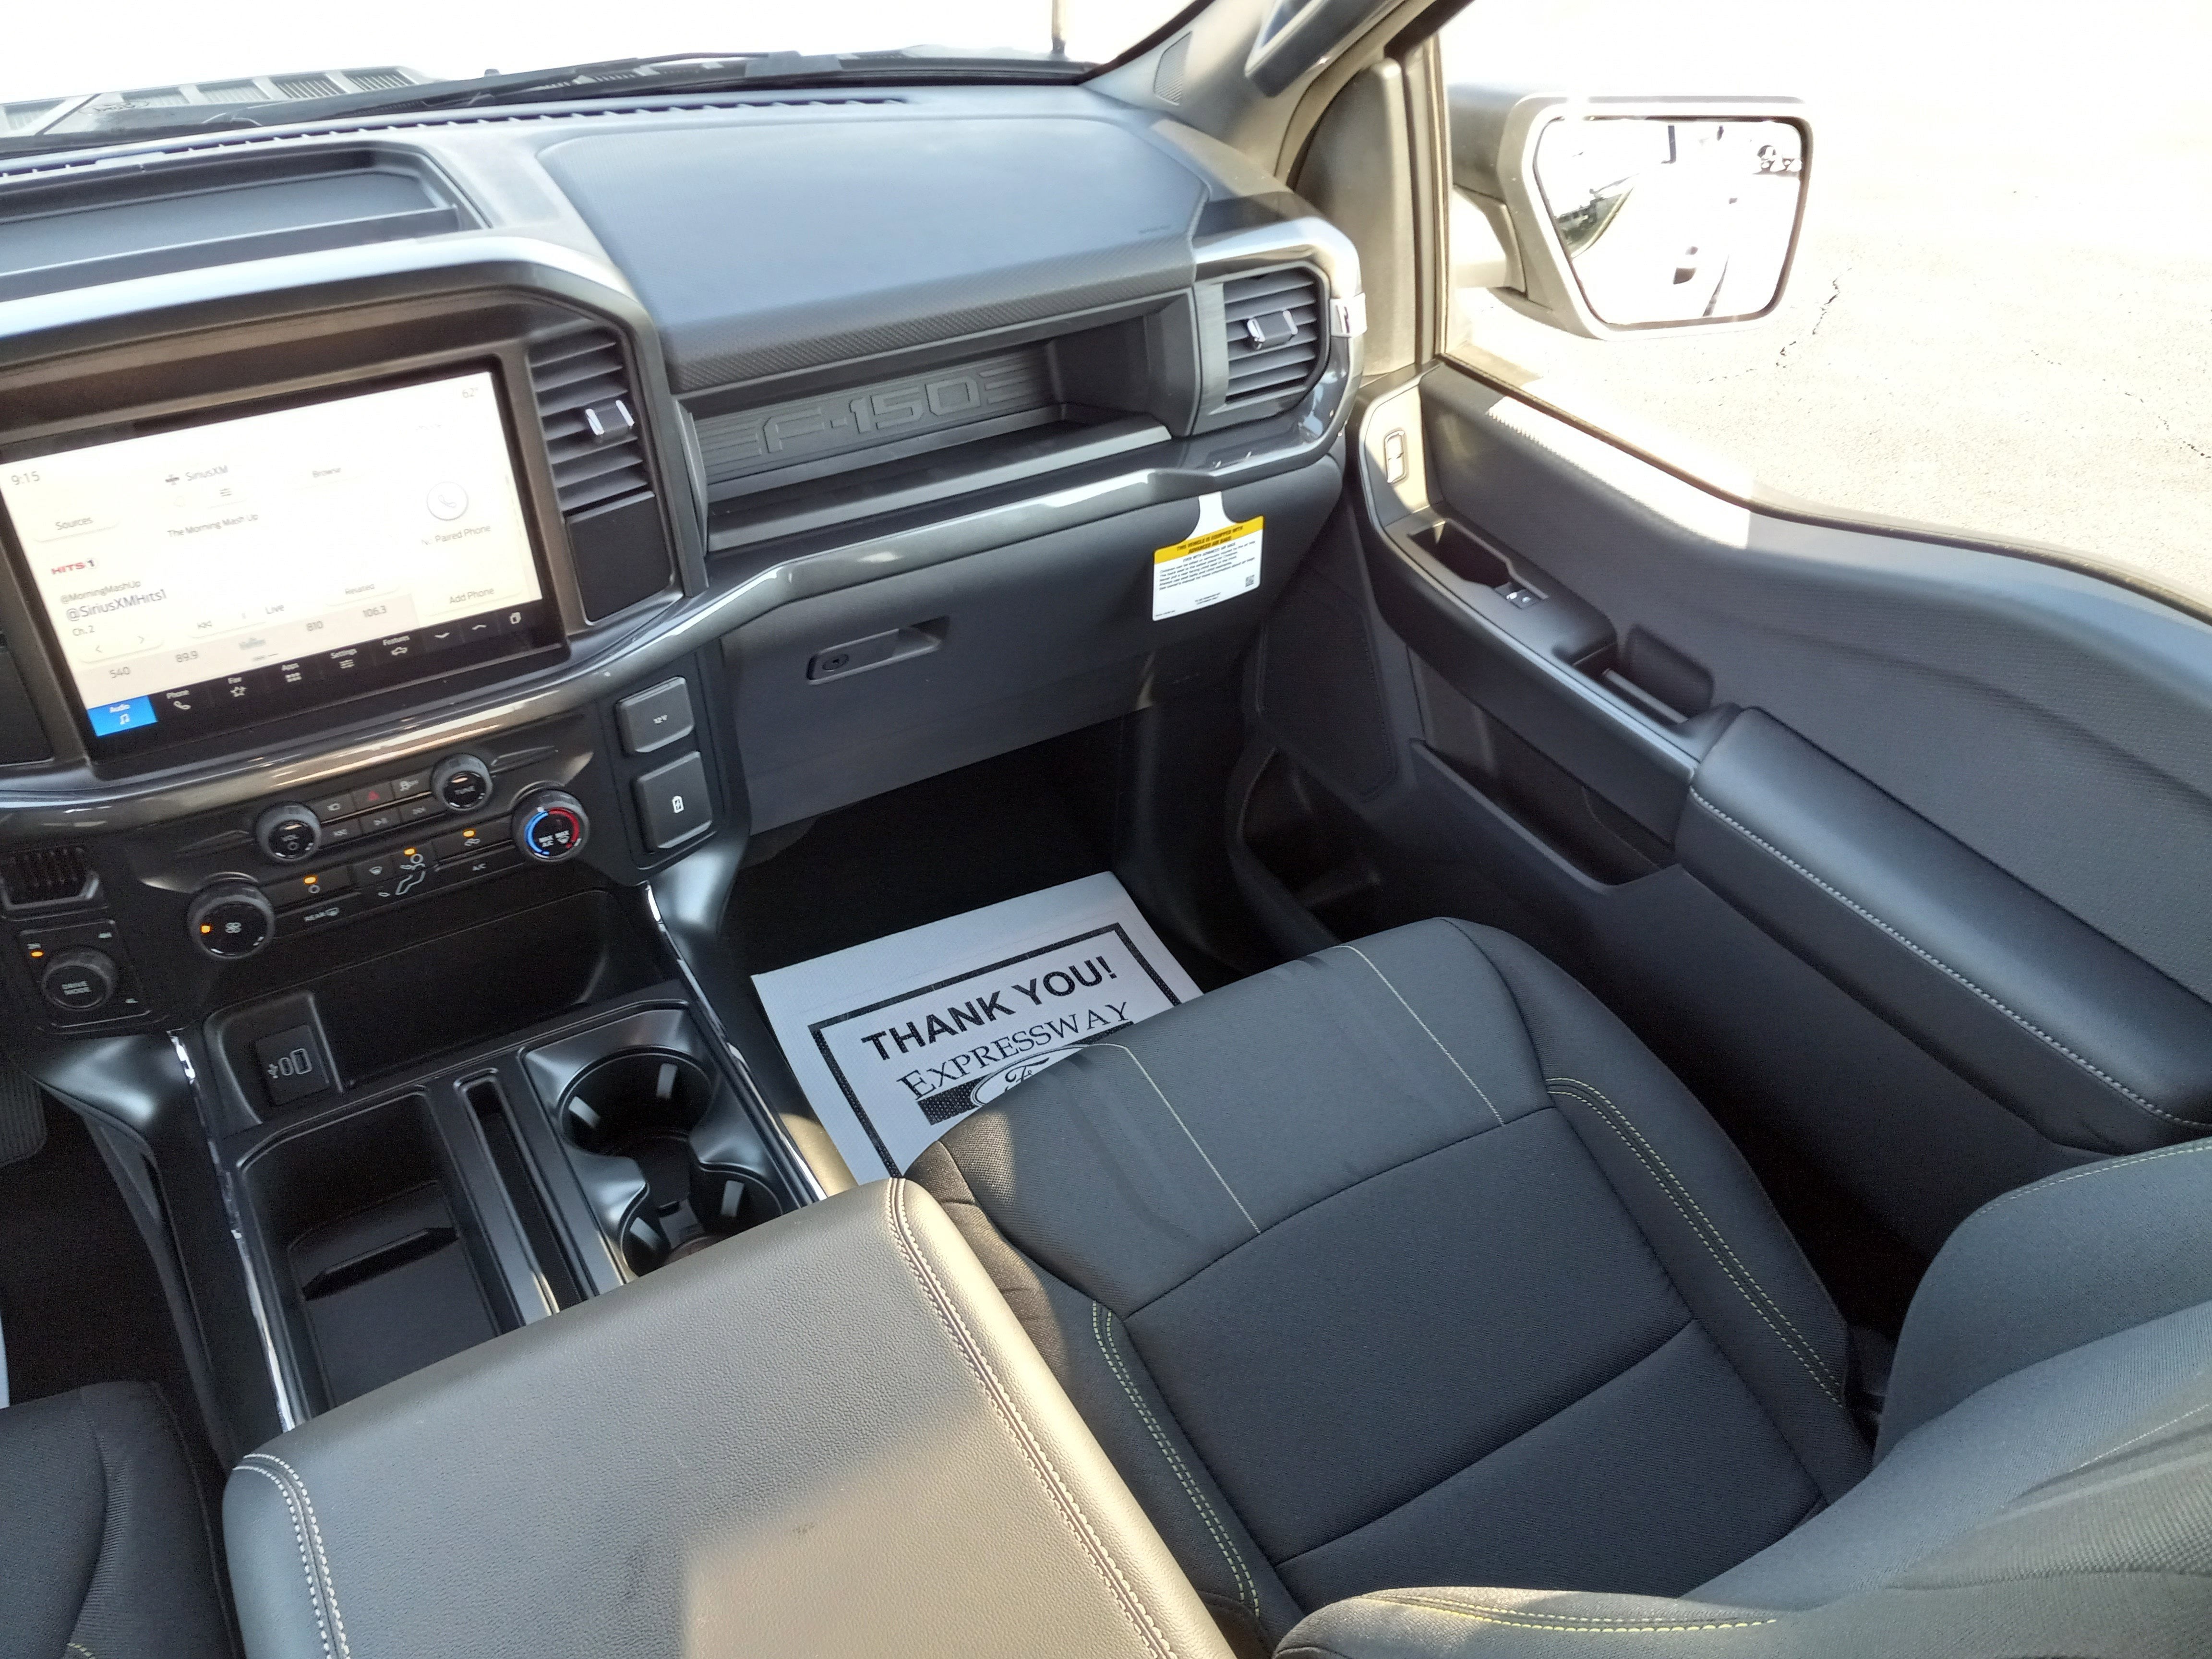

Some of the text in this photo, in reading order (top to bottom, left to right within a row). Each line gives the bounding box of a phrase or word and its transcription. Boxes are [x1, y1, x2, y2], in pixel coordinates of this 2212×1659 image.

[762, 377, 981, 453] F-150
[11, 471, 40, 485] 9:15
[185, 465, 229, 481] SiriusXM
[55, 517, 94, 530] Sources
[167, 529, 184, 538] The
[185, 521, 222, 535] Morning
[435, 531, 463, 543] Paired
[464, 524, 492, 538] Phone
[51, 561, 85, 575] HITS
[449, 586, 495, 605] Add Phone
[67, 589, 167, 622] @SiriusXMHits1
[265, 603, 285, 615] Live
[72, 625, 95, 637] Ch. 2
[383, 635, 410, 646] Features
[176, 651, 199, 663] 89.9
[331, 648, 357, 659] Settings
[109, 667, 131, 678] 540
[282, 662, 300, 672] Apps
[166, 689, 190, 700] Phone
[861, 955, 1118, 1060] THANK YOU!
[897, 1001, 1130, 1101] EXPRESSWAY
